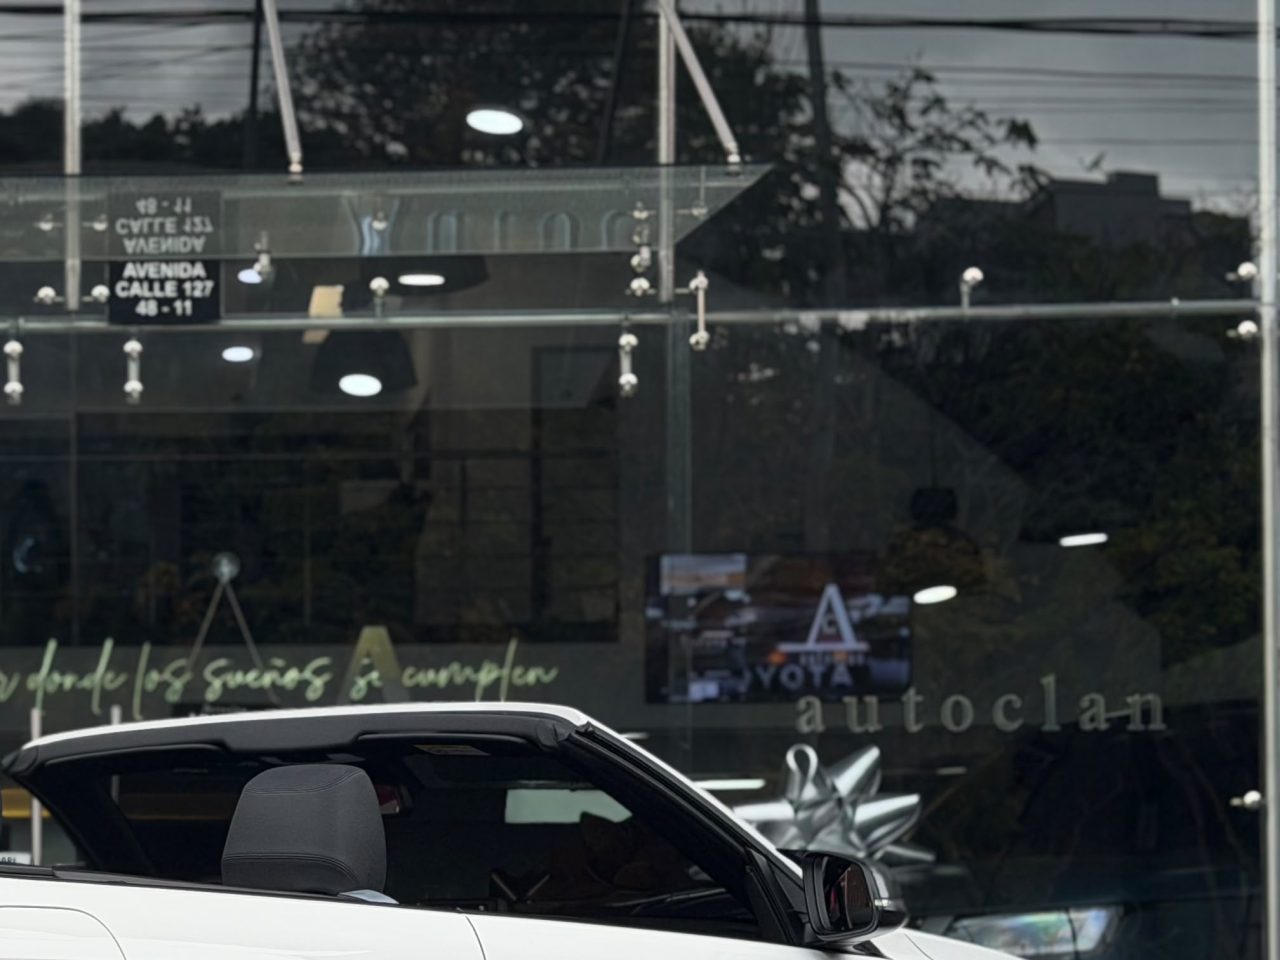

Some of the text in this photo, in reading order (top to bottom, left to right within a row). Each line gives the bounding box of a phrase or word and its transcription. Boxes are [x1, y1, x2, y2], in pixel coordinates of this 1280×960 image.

[122, 261, 207, 279] AVENIDA
[115, 281, 215, 298] CALLE 127
[135, 299, 158, 317] 48
[173, 299, 193, 316] 11
[26, 637, 126, 716] donde
[131, 641, 193, 720] los
[401, 636, 559, 702] cumplen
[795, 674, 1167, 733] autoclan
